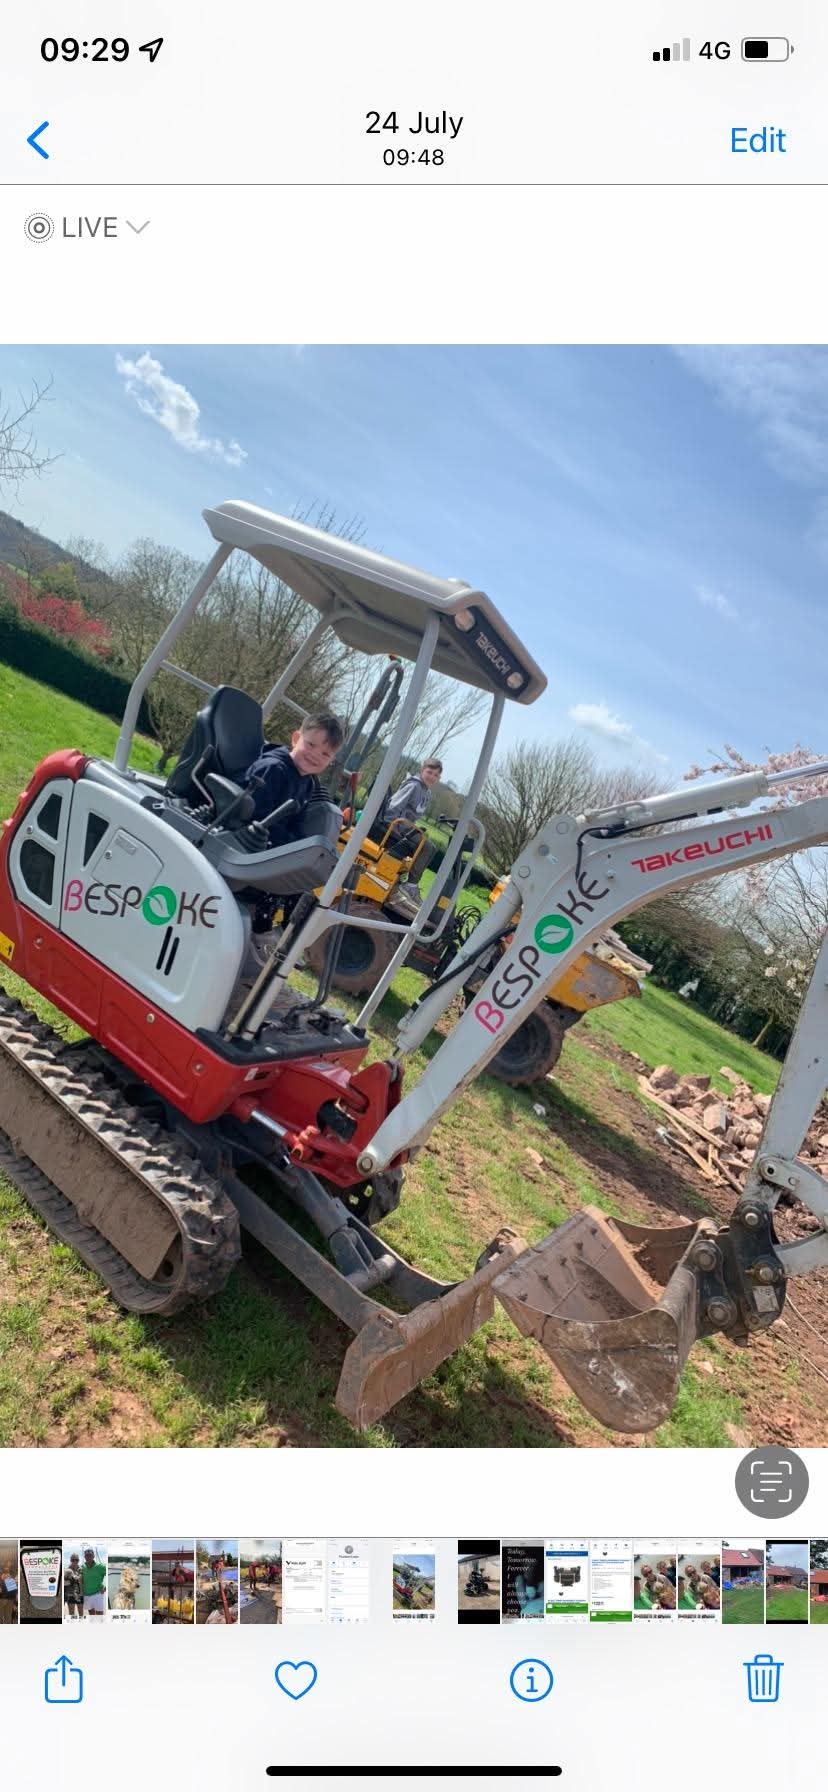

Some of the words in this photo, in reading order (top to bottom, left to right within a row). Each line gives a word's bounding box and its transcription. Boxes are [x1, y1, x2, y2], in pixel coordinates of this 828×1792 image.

[40, 38, 130, 63] 09:29
[698, 41, 731, 61] 4G
[365, 110, 400, 134] 24
[408, 110, 464, 140] July
[731, 126, 787, 154] Edit
[382, 148, 445, 167] 09:48
[62, 216, 118, 238] LIVE
[64, 879, 222, 928] BESPOKE
[474, 871, 609, 1035] BESPOKE
